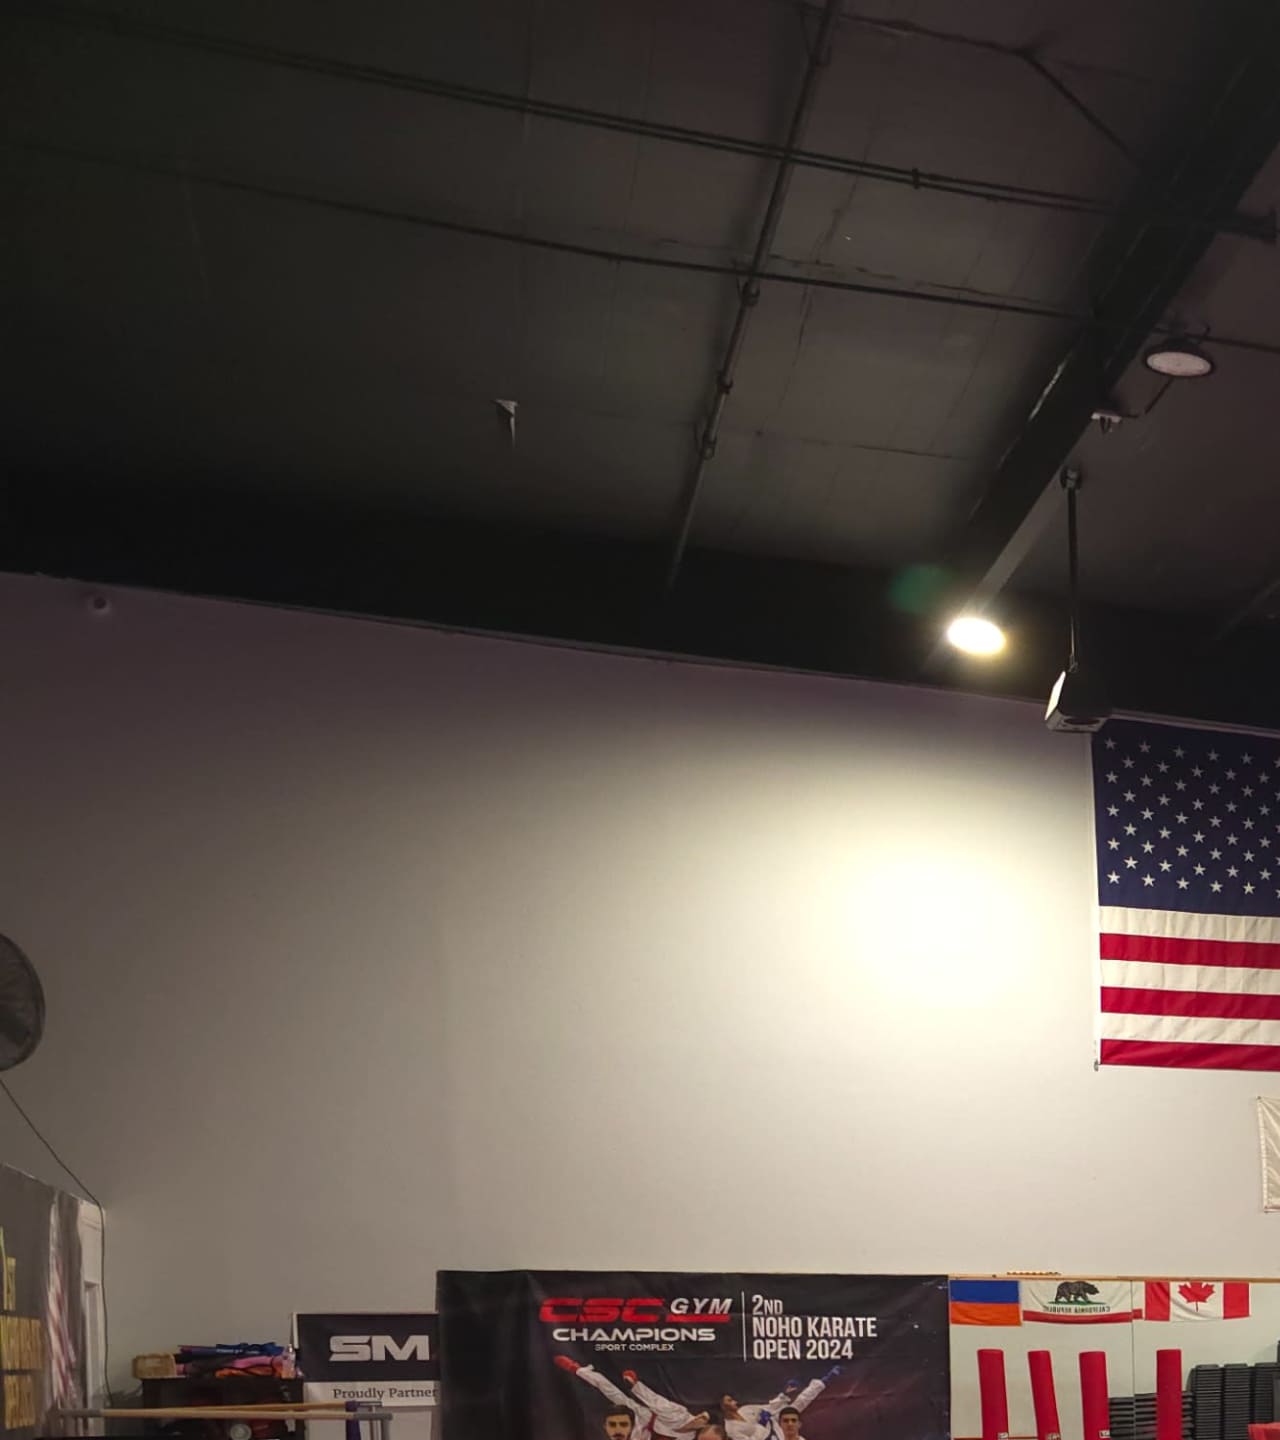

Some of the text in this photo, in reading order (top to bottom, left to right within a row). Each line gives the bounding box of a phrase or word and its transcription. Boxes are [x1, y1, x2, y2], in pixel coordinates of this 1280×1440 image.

[539, 1297, 733, 1323] CSC GYM
[752, 1294, 783, 1316] 2ND
[552, 1328, 716, 1342] CHAMPIONS
[752, 1317, 878, 1338] NOHO KARATE
[329, 1335, 431, 1361] SM
[595, 1343, 675, 1351] SPORT COMPLEX
[753, 1339, 854, 1360] OPEN 2024
[333, 1388, 385, 1400] Proudly
